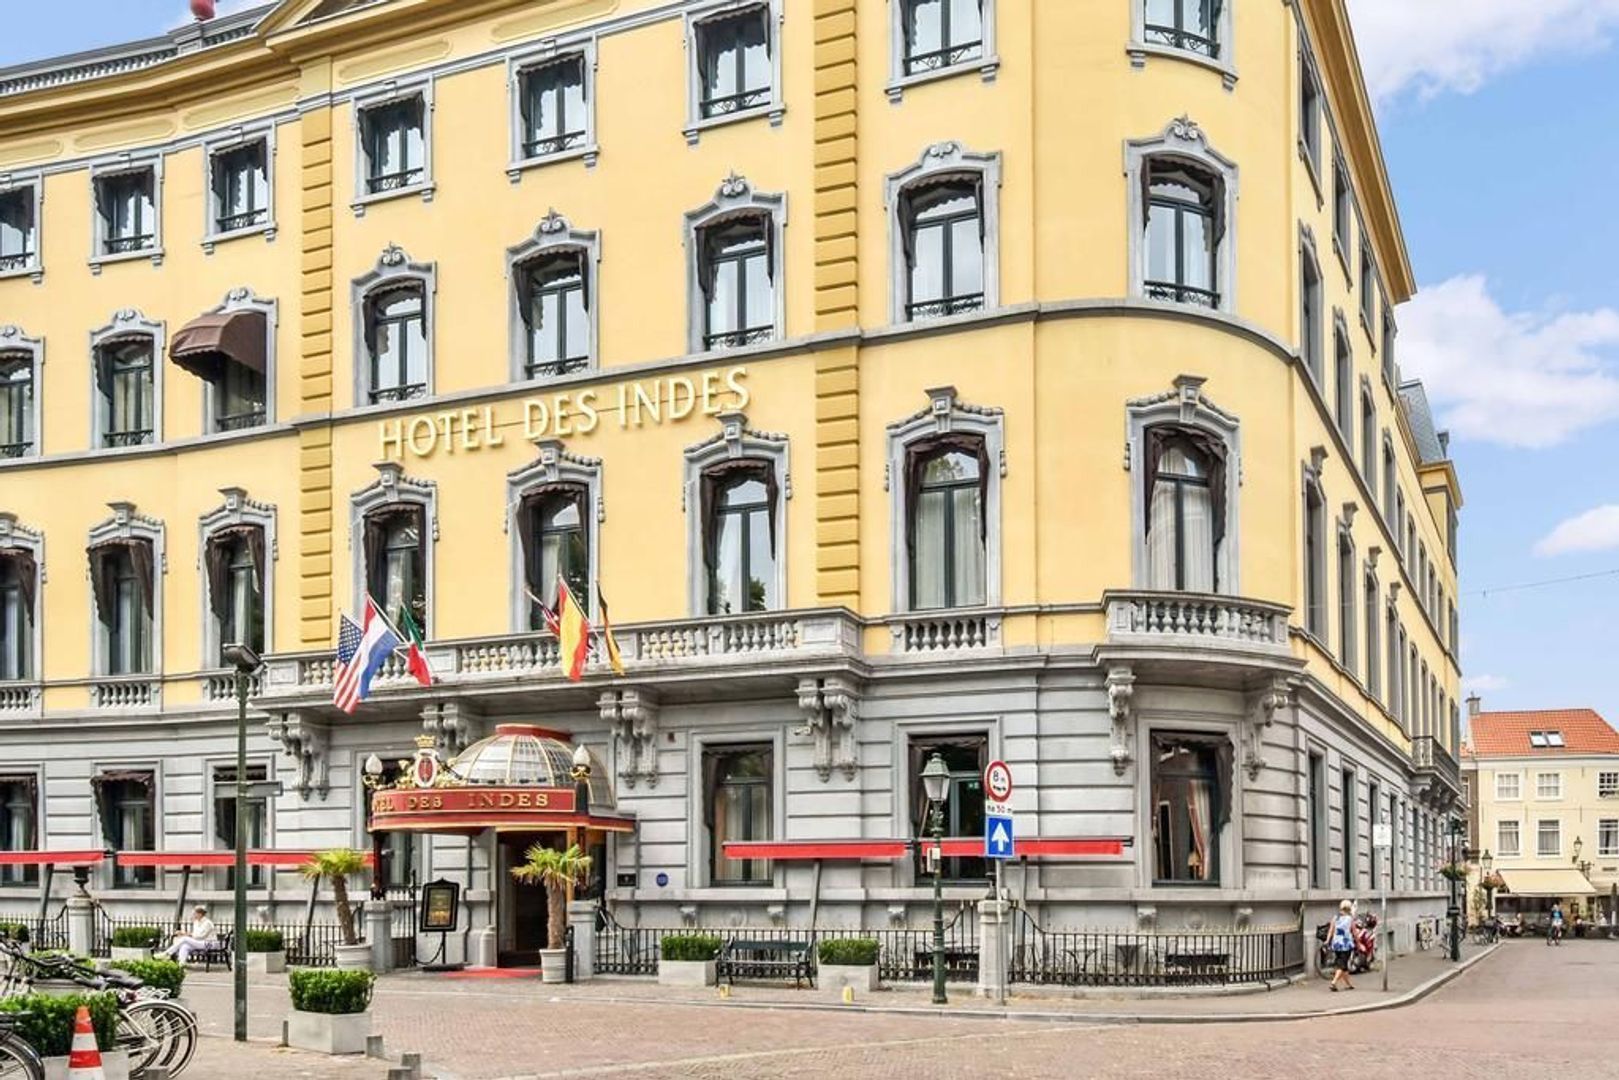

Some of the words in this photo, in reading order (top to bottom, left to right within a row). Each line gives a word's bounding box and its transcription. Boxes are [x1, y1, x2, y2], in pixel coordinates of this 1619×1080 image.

[379, 406, 504, 461] HOTEL
[522, 390, 599, 441] DES
[619, 366, 751, 428] INDES
[408, 795, 443, 809] DES
[468, 793, 549, 807] INDES
